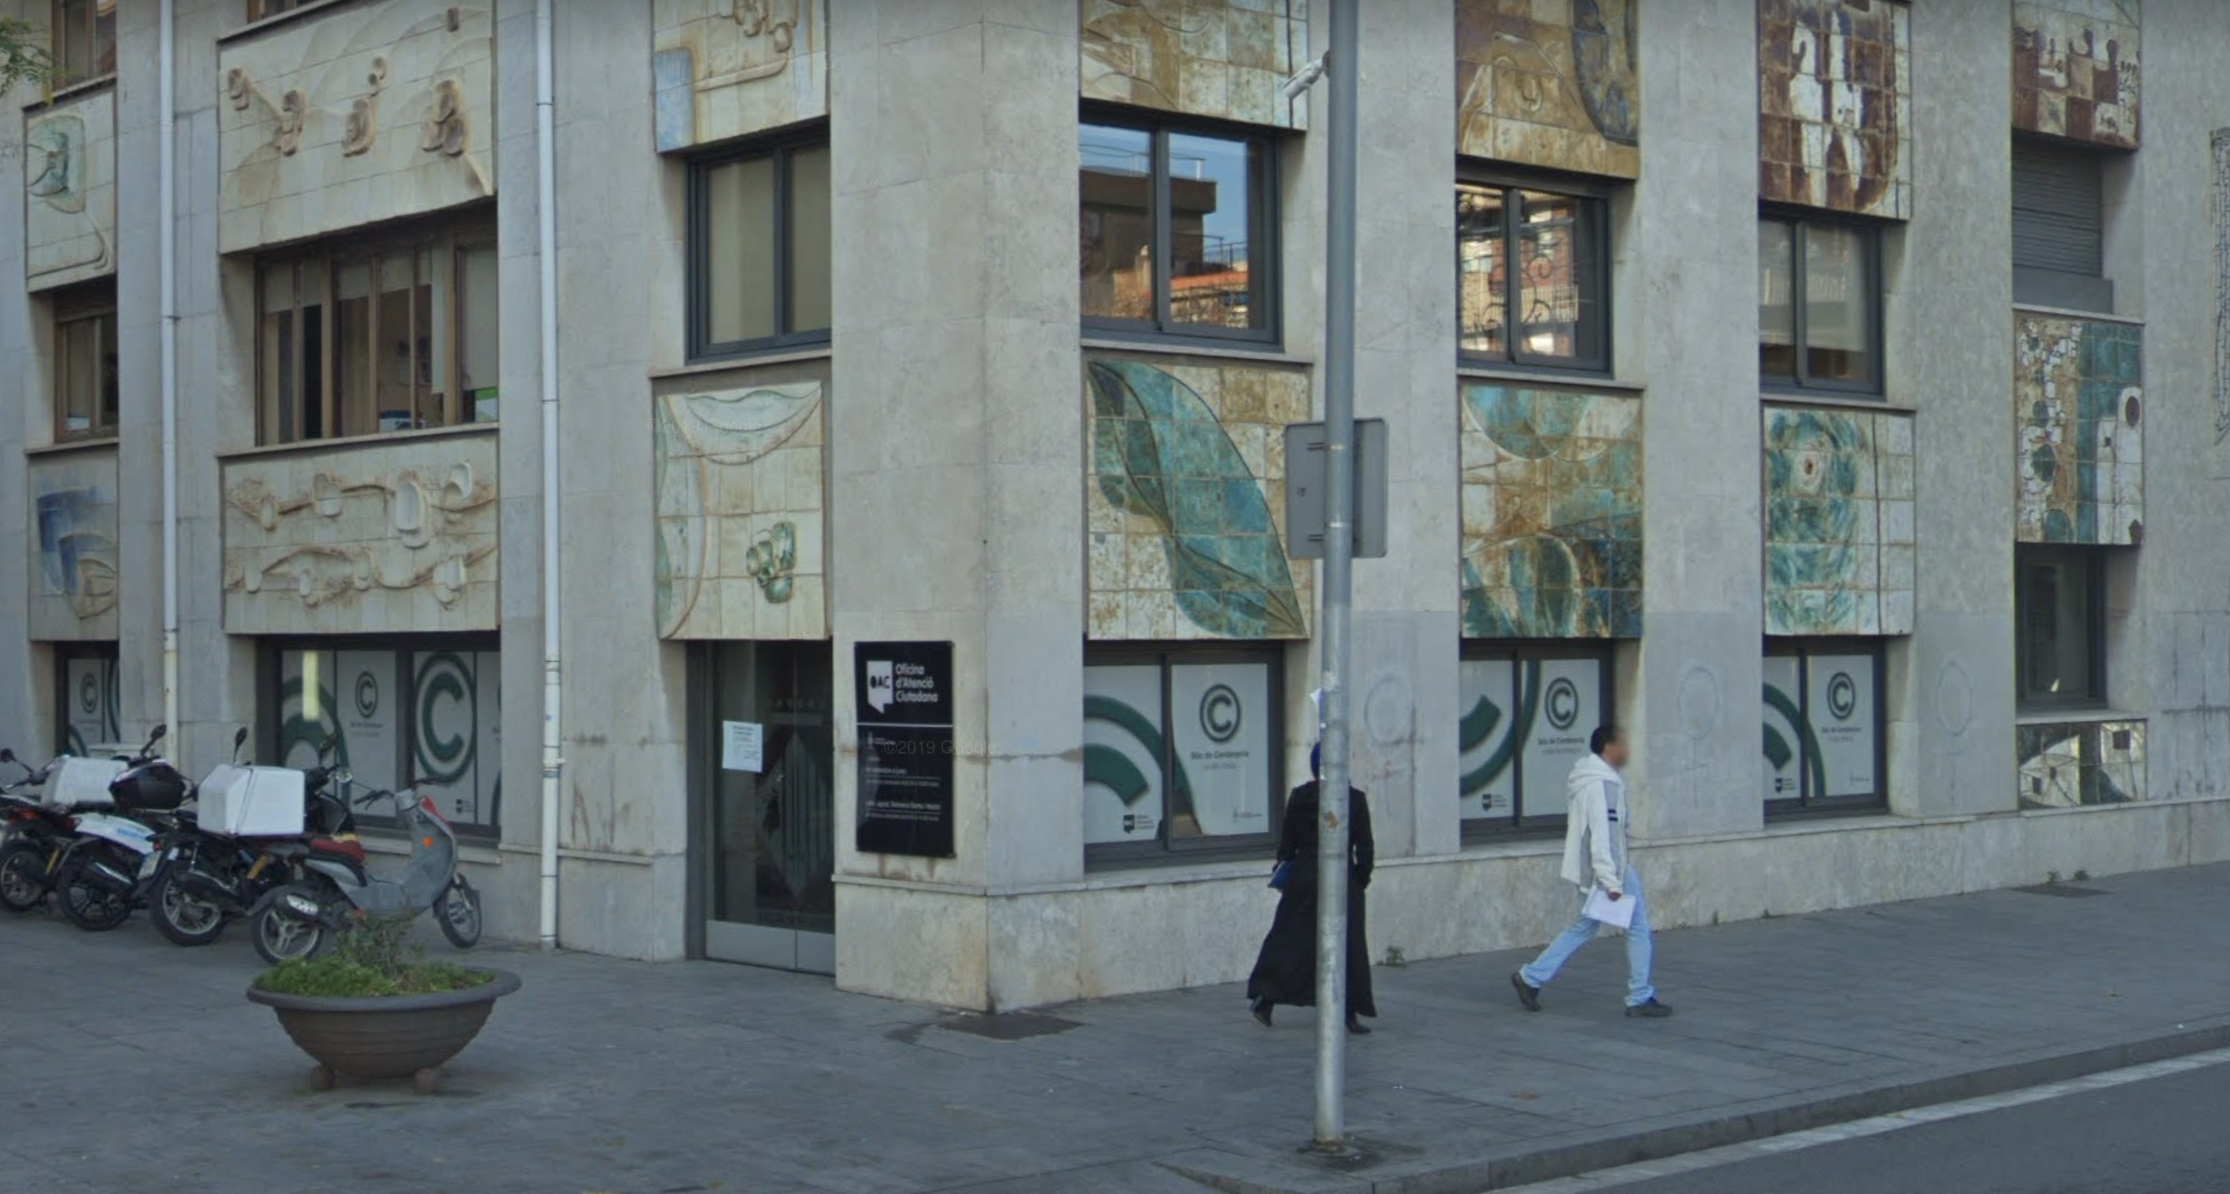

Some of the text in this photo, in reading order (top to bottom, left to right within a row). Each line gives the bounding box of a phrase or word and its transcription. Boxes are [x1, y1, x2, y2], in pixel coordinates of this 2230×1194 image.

[896, 664, 925, 675] Oficina
[870, 675, 891, 690] OAC
[896, 676, 934, 689] d'Atenció
[896, 690, 939, 702] Ciutadana
